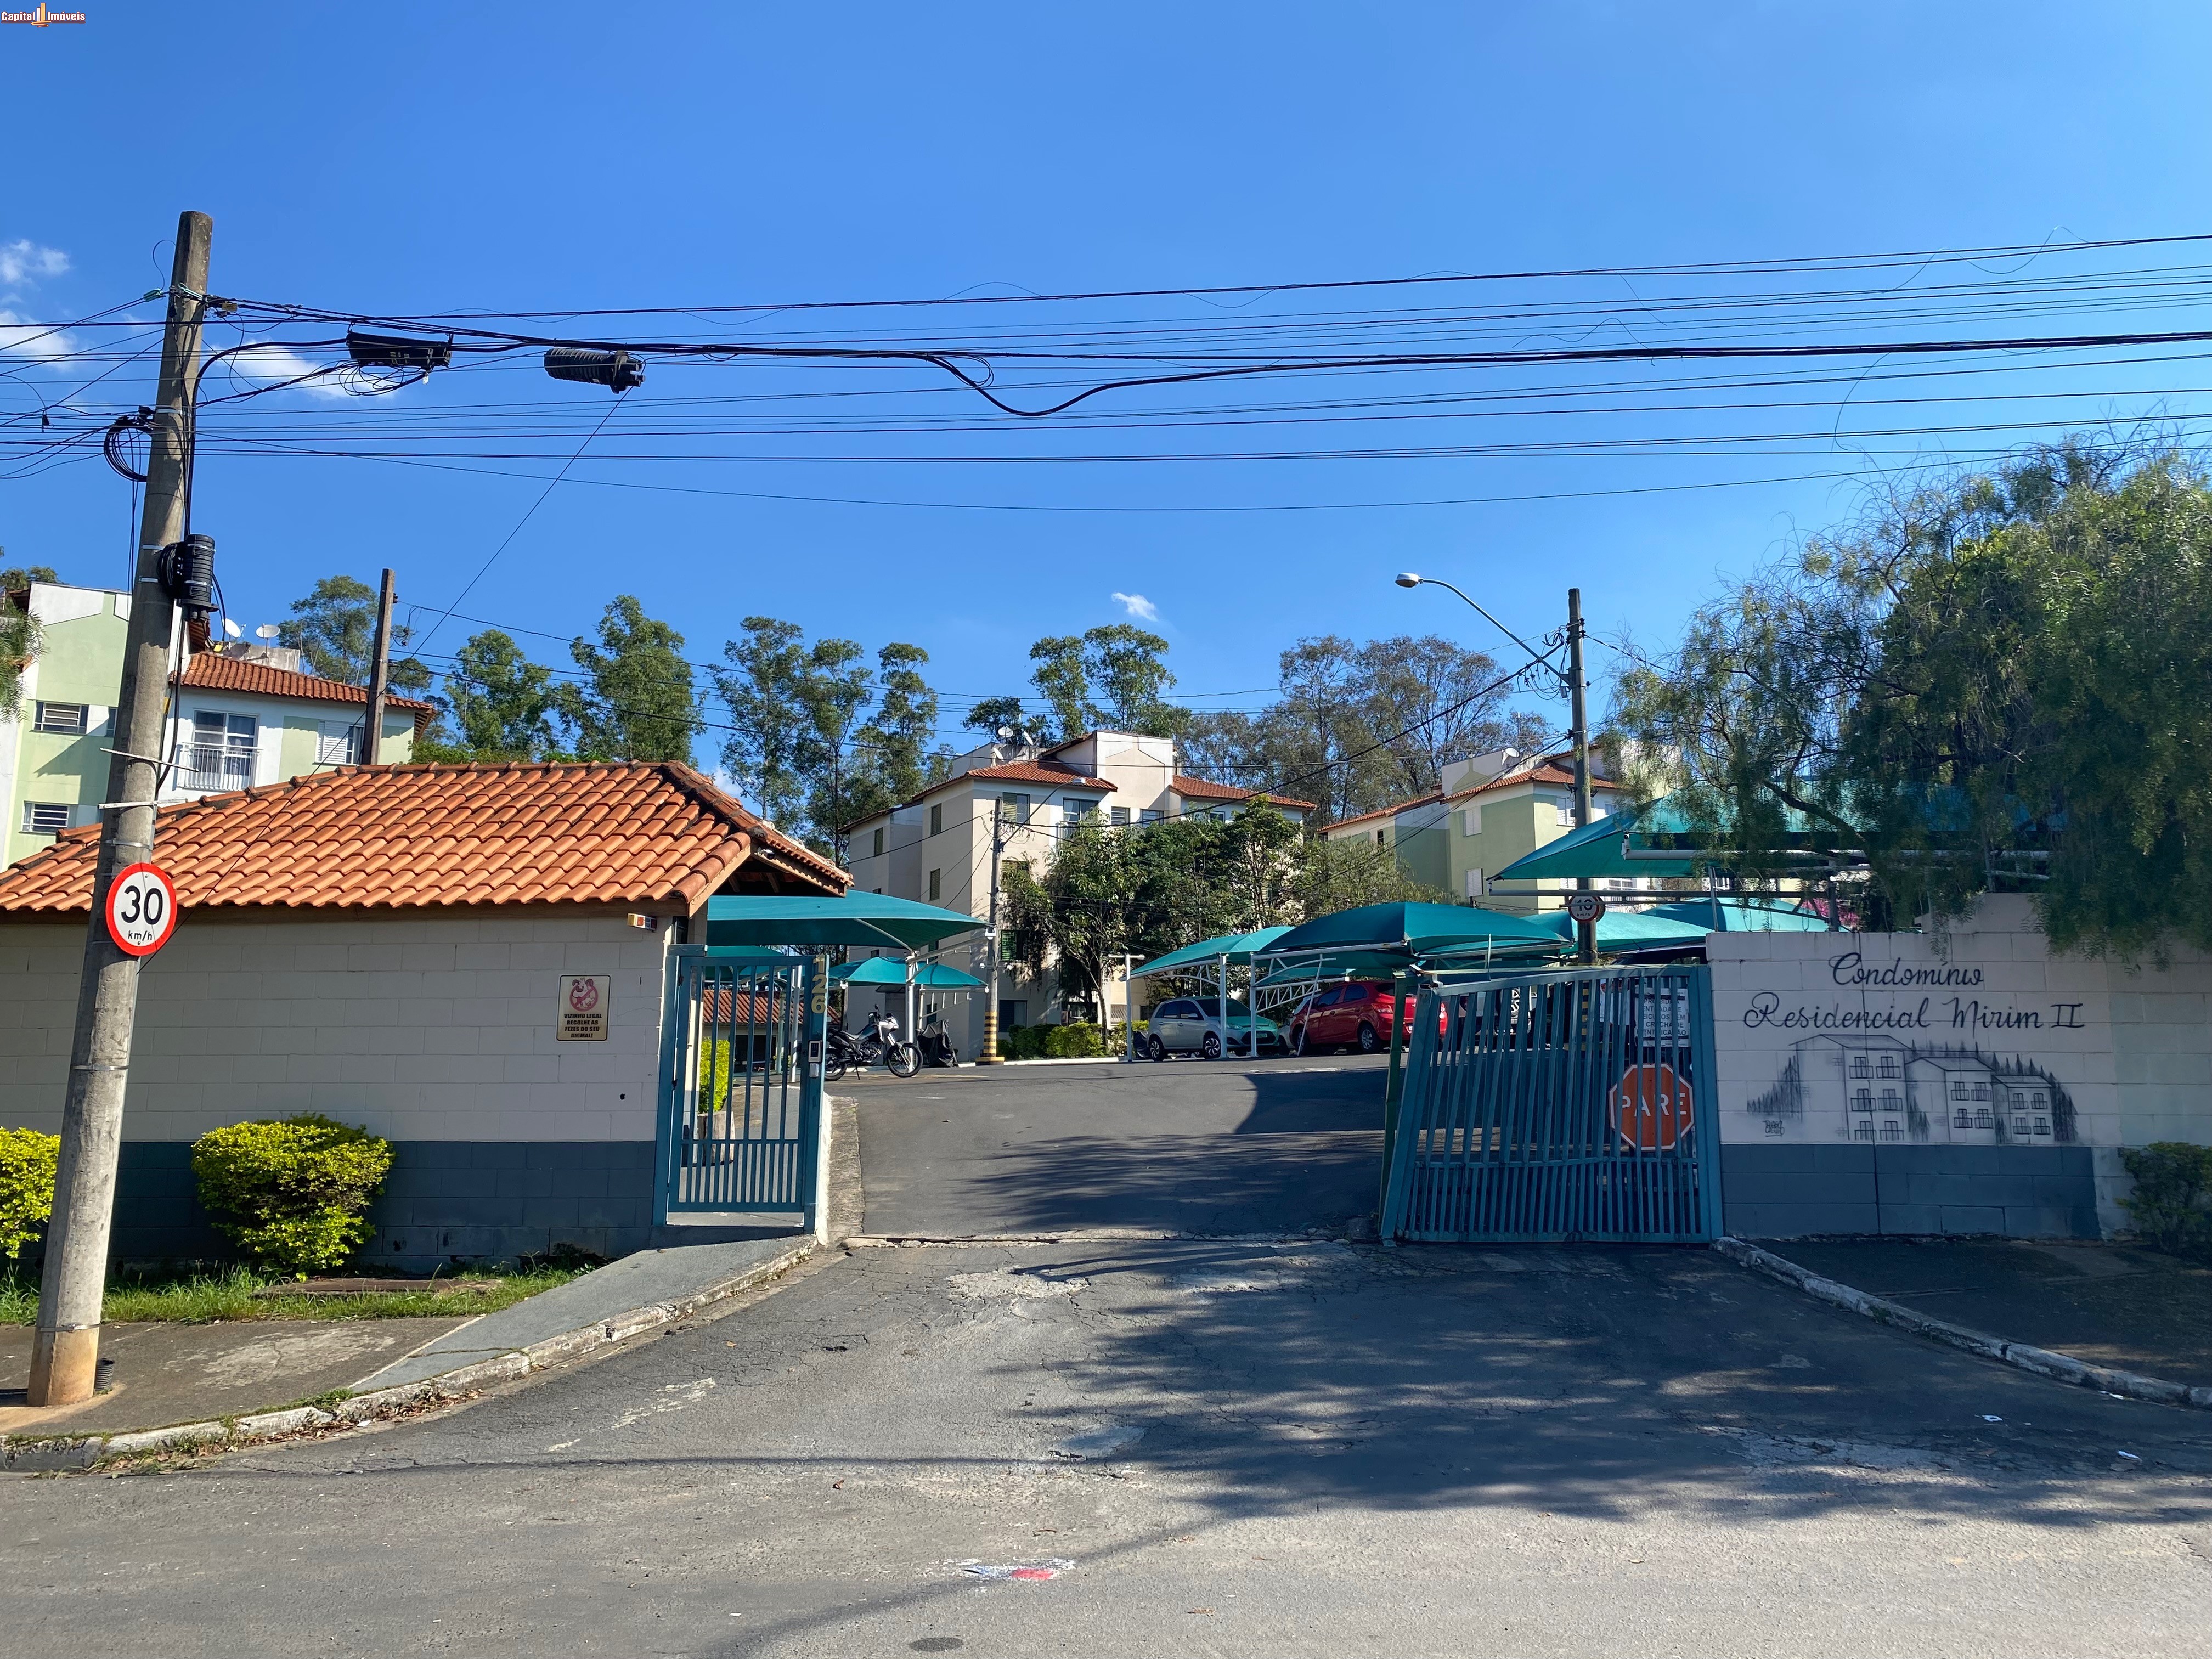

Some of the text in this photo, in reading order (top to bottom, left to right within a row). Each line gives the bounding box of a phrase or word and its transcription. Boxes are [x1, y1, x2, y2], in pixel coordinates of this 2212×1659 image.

[121, 885, 163, 925] 30
[1576, 899, 1593, 911] 10
[128, 930, 153, 941] km/h
[811, 953, 827, 1014] 126
[1829, 952, 1984, 985] Condomínio
[1743, 992, 2085, 1039] Residencial Mirim II
